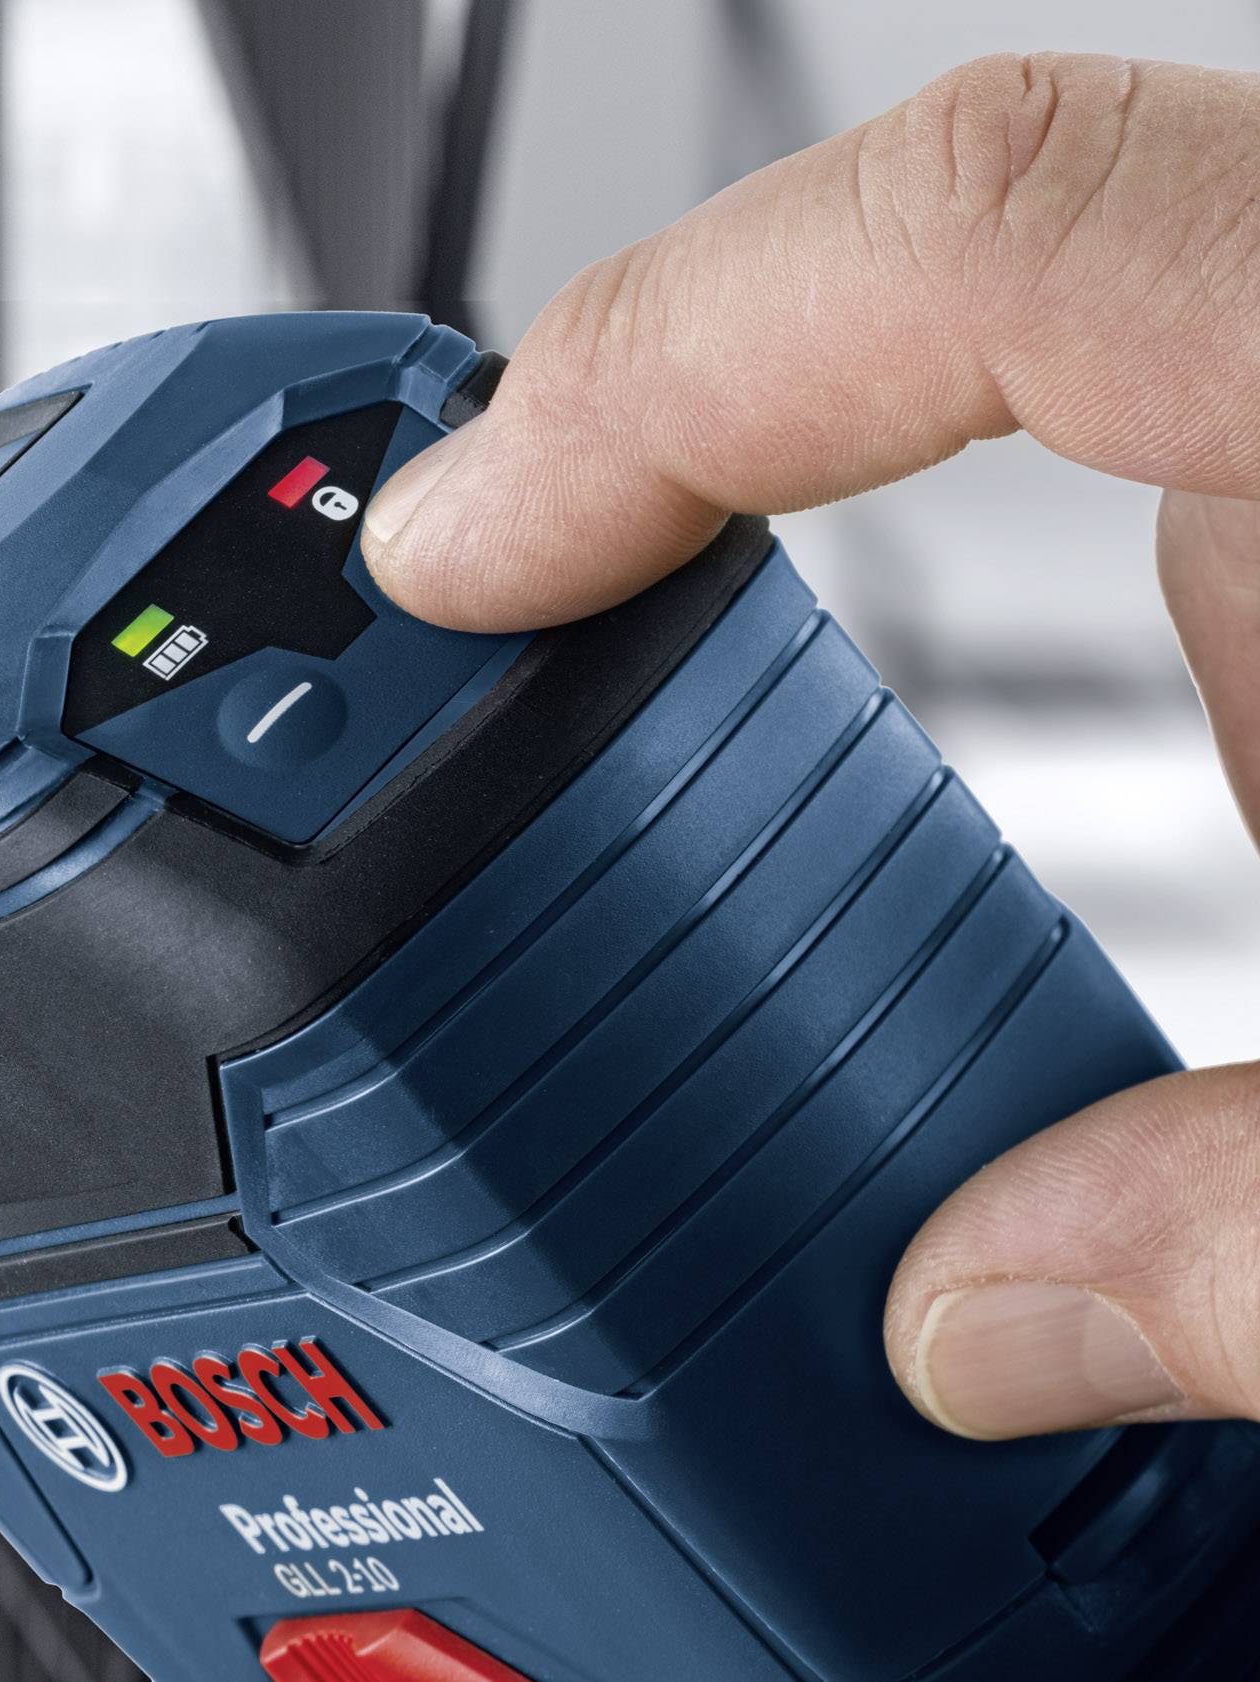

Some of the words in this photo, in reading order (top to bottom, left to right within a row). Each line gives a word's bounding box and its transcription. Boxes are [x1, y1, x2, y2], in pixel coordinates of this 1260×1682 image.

[98, 1337, 387, 1457] BOSCH
[220, 1478, 485, 1555] Professional
[274, 1562, 342, 1598] GLL
[330, 1557, 400, 1594] 2-10
